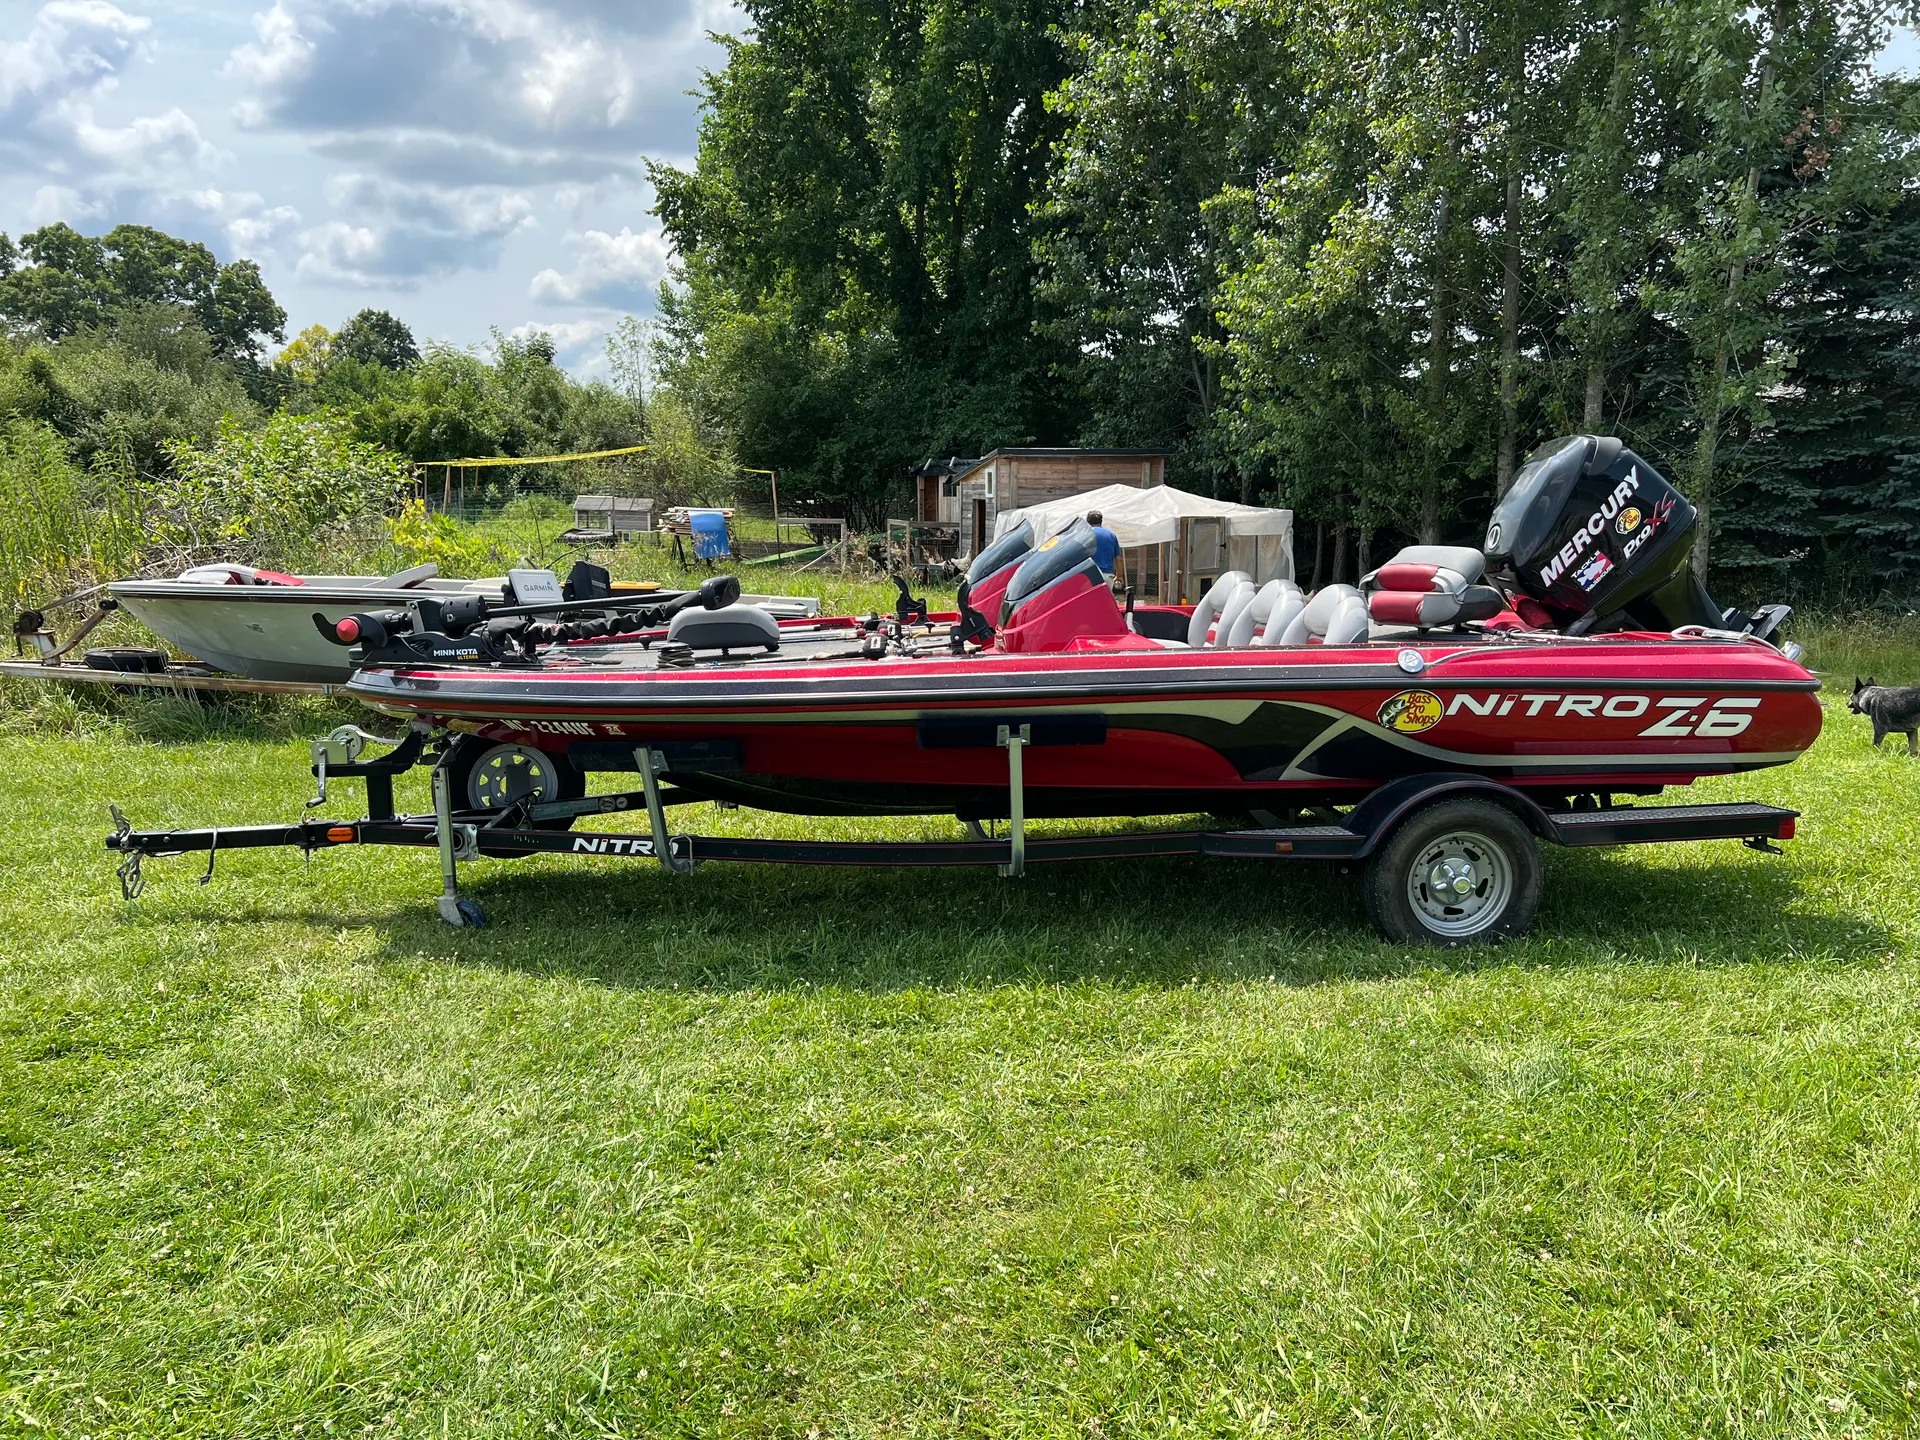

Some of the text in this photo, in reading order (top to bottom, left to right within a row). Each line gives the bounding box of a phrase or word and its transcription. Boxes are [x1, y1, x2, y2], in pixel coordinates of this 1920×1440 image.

[1540, 465, 1640, 588] MERCURY
[1570, 549, 1601, 579] TACKLE
[524, 584, 554, 592] GARMIN
[1407, 692, 1432, 704] Bass
[1407, 703, 1425, 713] Pro
[1403, 713, 1436, 726] Shops
